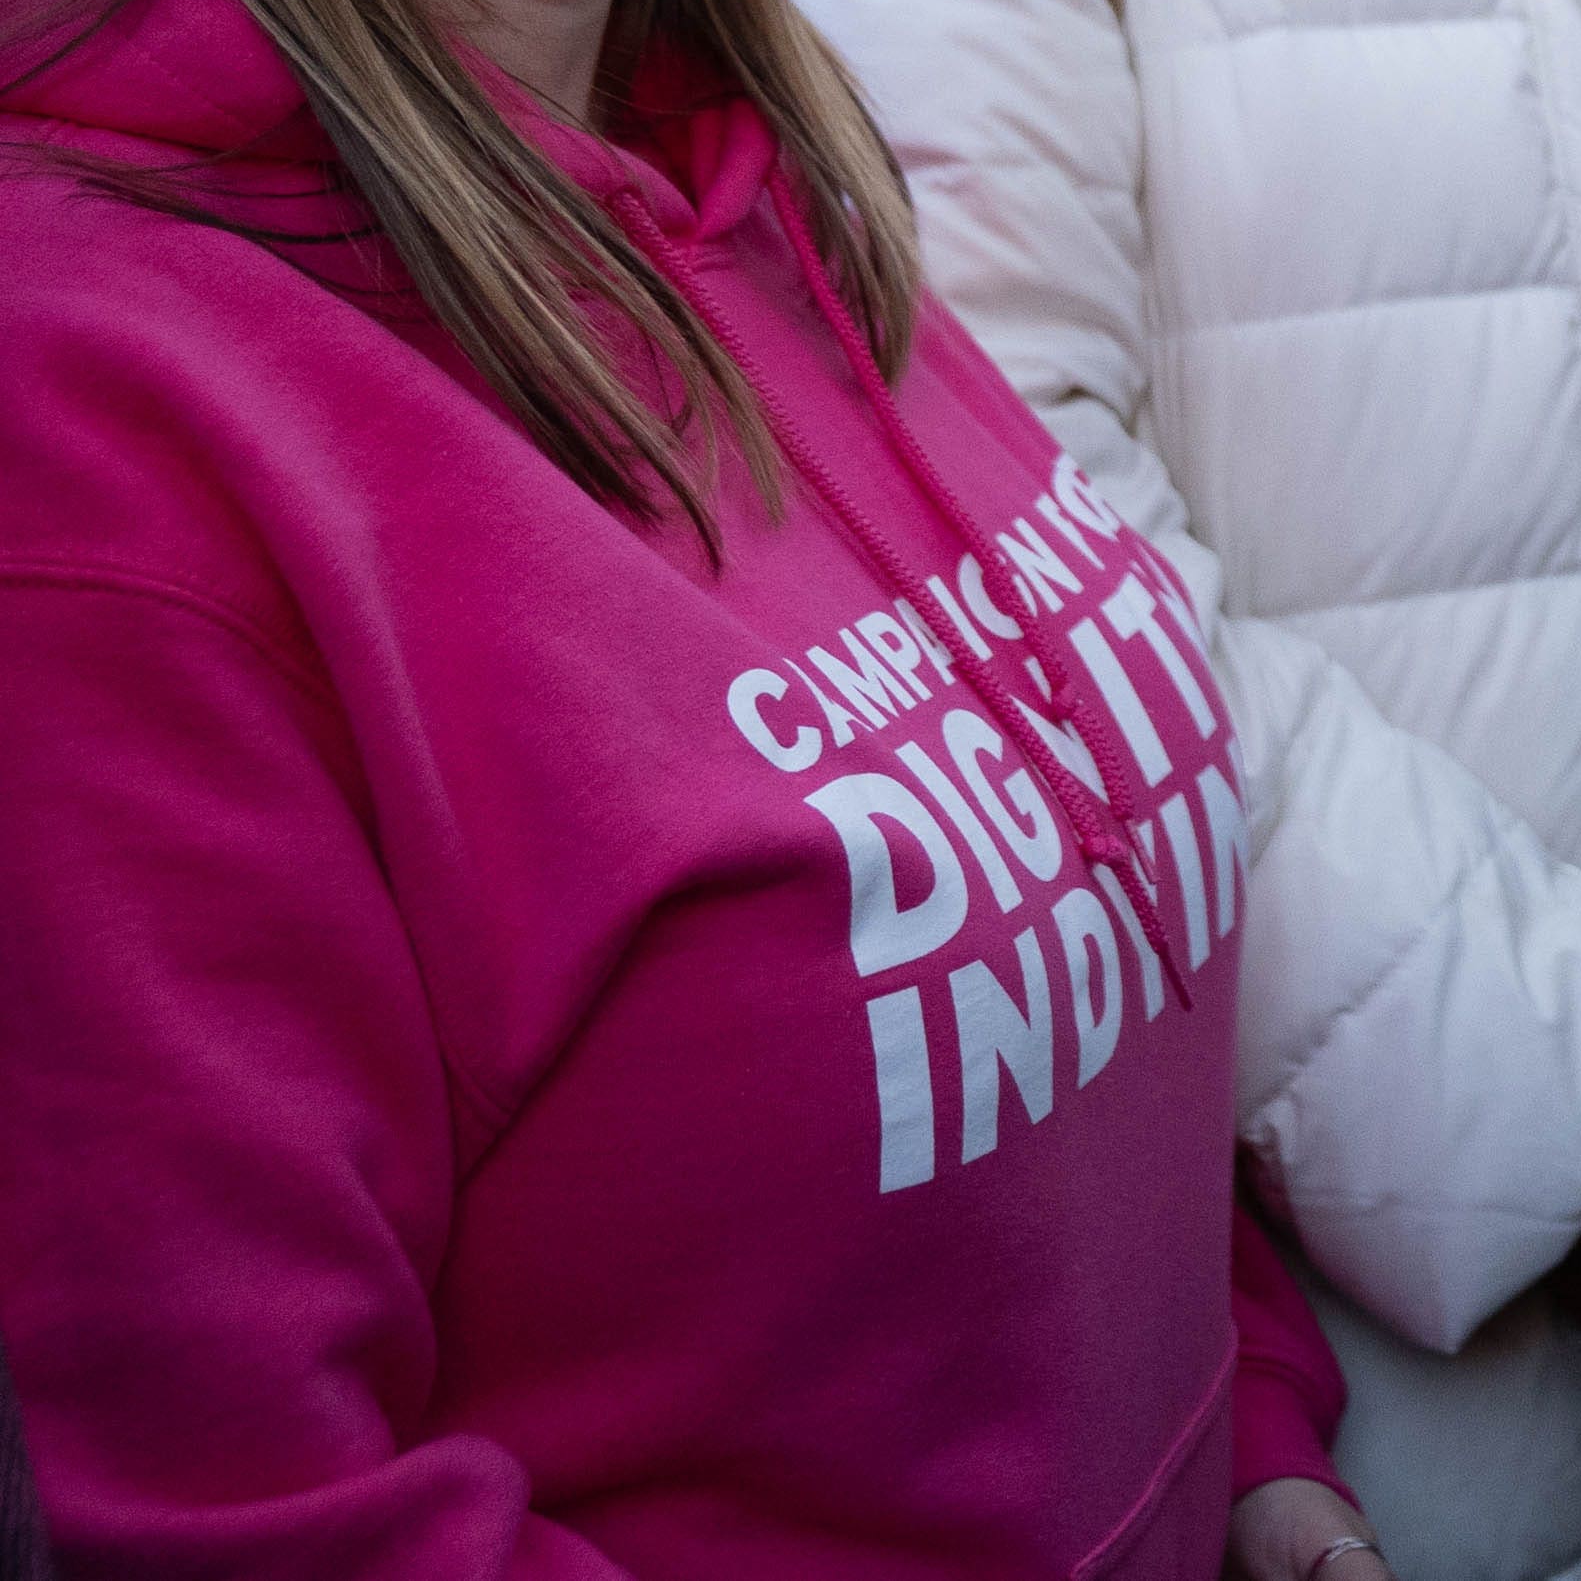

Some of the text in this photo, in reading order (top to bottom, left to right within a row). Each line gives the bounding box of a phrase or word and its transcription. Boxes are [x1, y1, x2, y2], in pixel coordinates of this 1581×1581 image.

[726, 516, 1084, 772] CAMPAIGN
[804, 539, 1218, 977] DIGNITY
[1052, 739, 1249, 1090] DYIN
